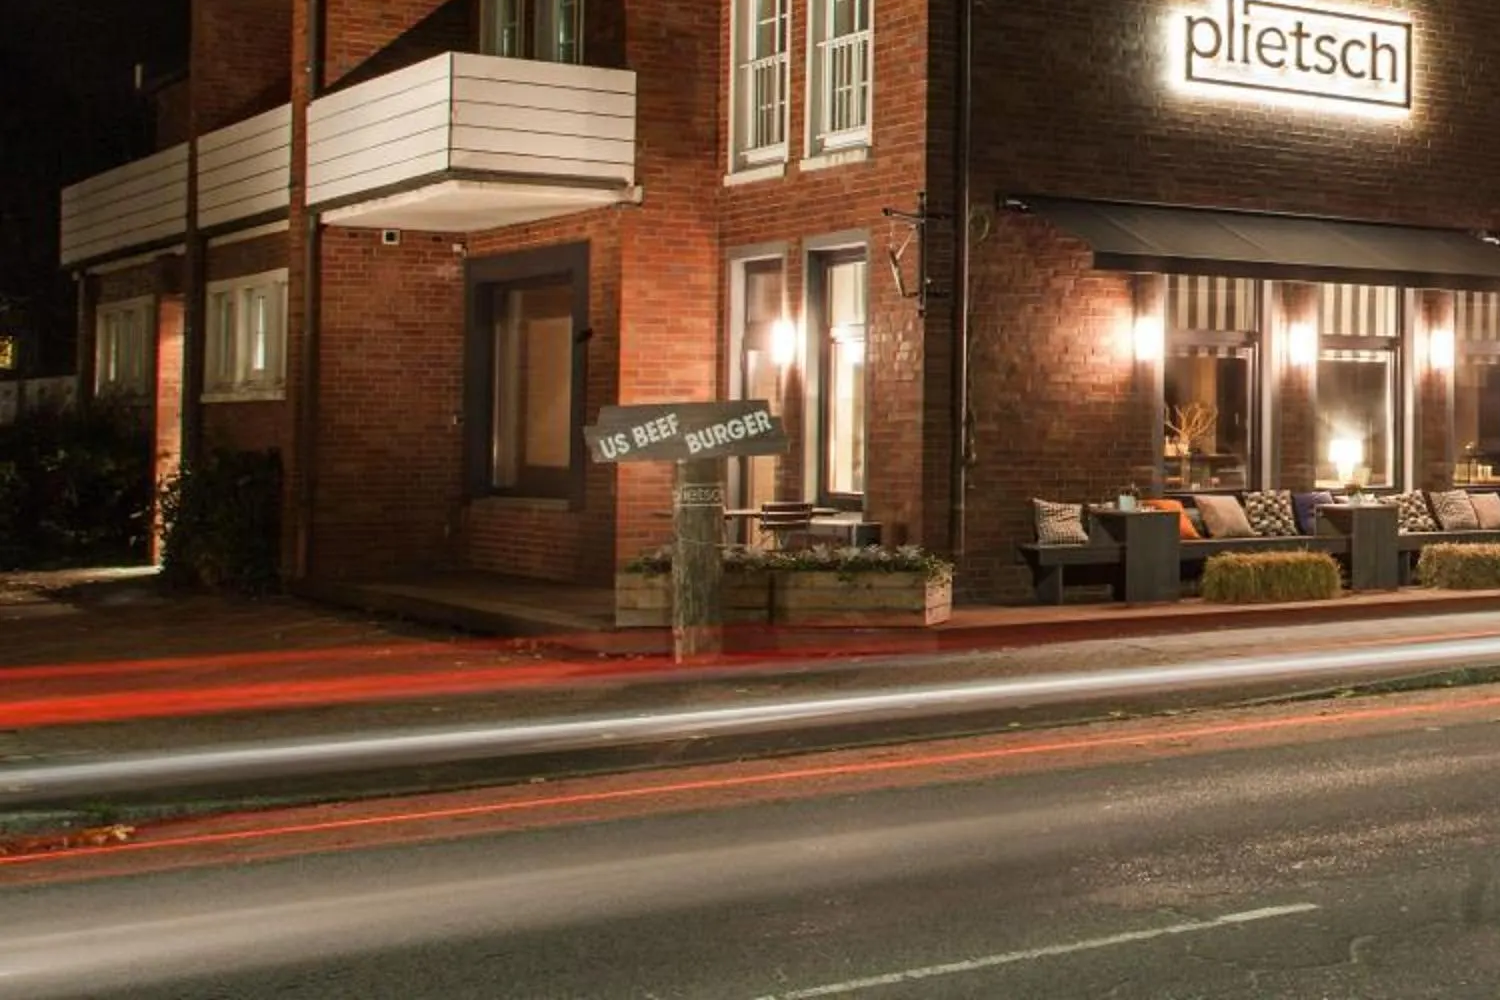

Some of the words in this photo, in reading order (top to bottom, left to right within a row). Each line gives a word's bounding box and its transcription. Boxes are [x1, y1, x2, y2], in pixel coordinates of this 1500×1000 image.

[600, 433, 629, 460] US
[633, 413, 680, 447] BEEF
[685, 411, 772, 453] BURGER
